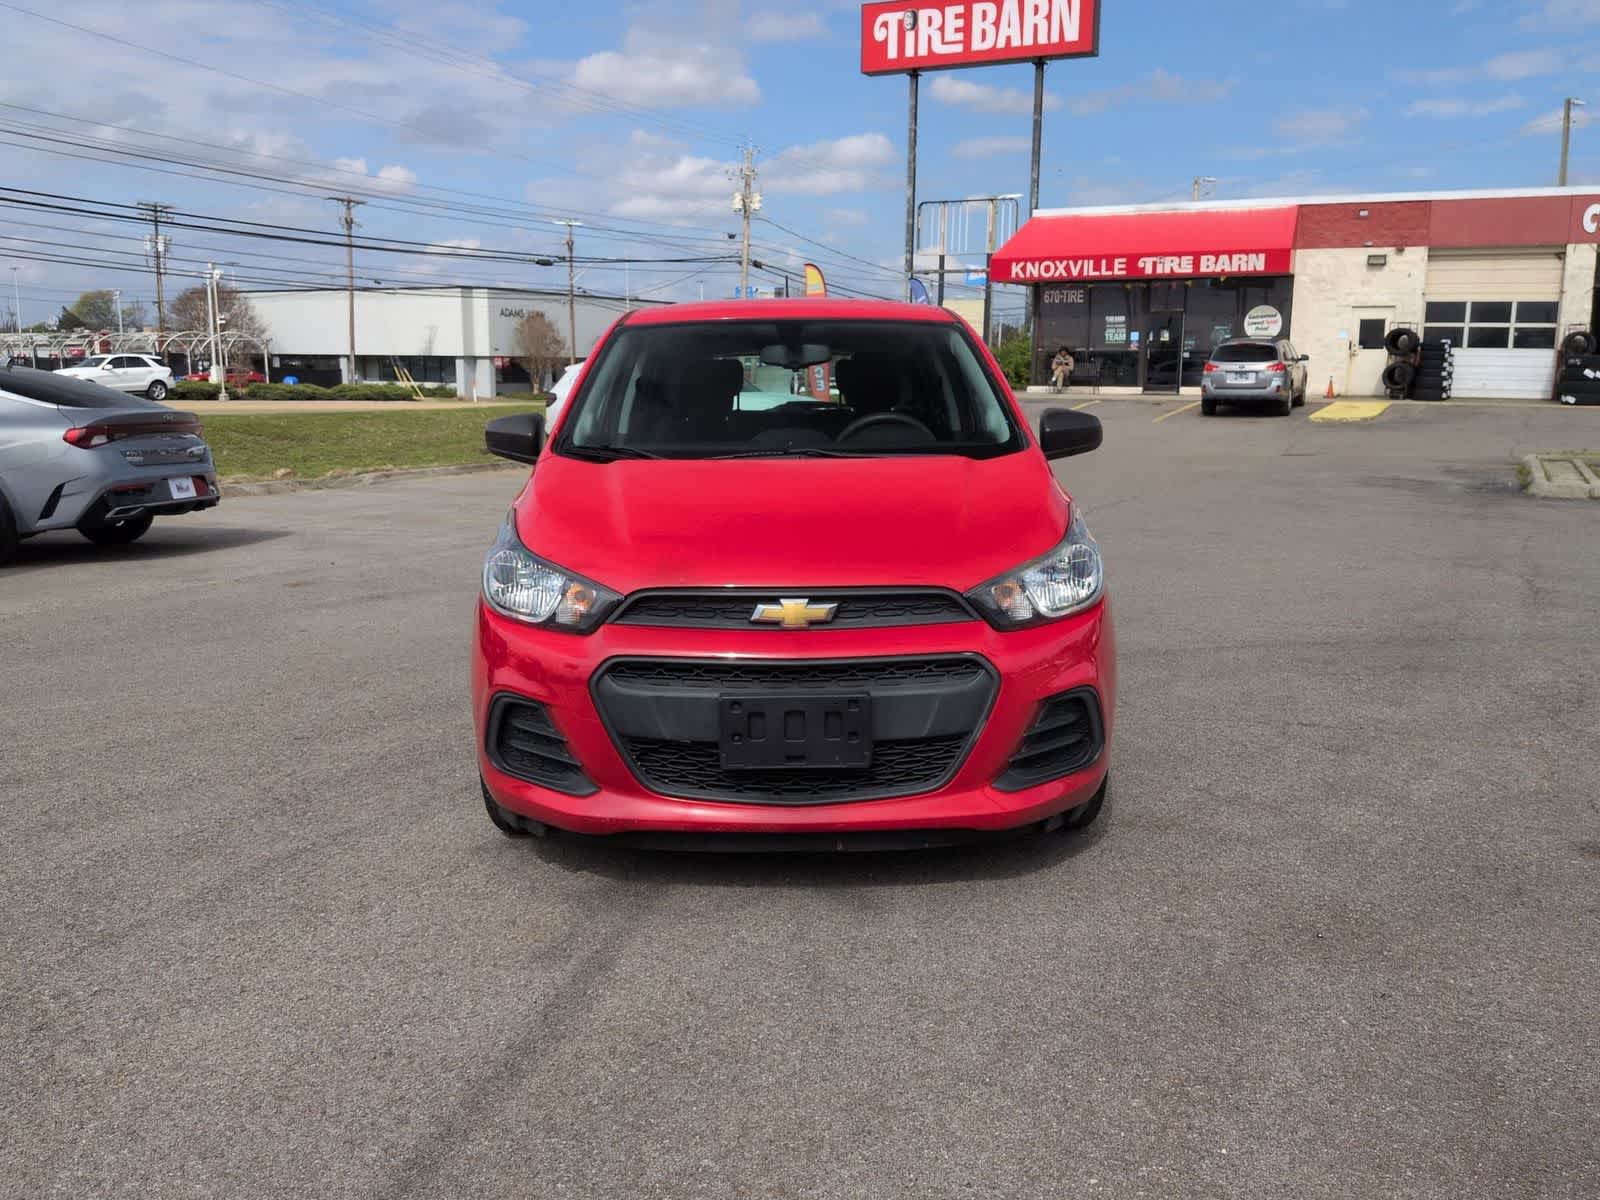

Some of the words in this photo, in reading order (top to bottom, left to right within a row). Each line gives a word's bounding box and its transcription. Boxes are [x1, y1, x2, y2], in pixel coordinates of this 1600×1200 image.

[970, 0, 1082, 52] BARN
[1011, 258, 1127, 278] KNOXVILLE
[1200, 253, 1266, 272] BARN
[499, 307, 525, 319] ADAMS
[1105, 333, 1127, 341] TEAM
